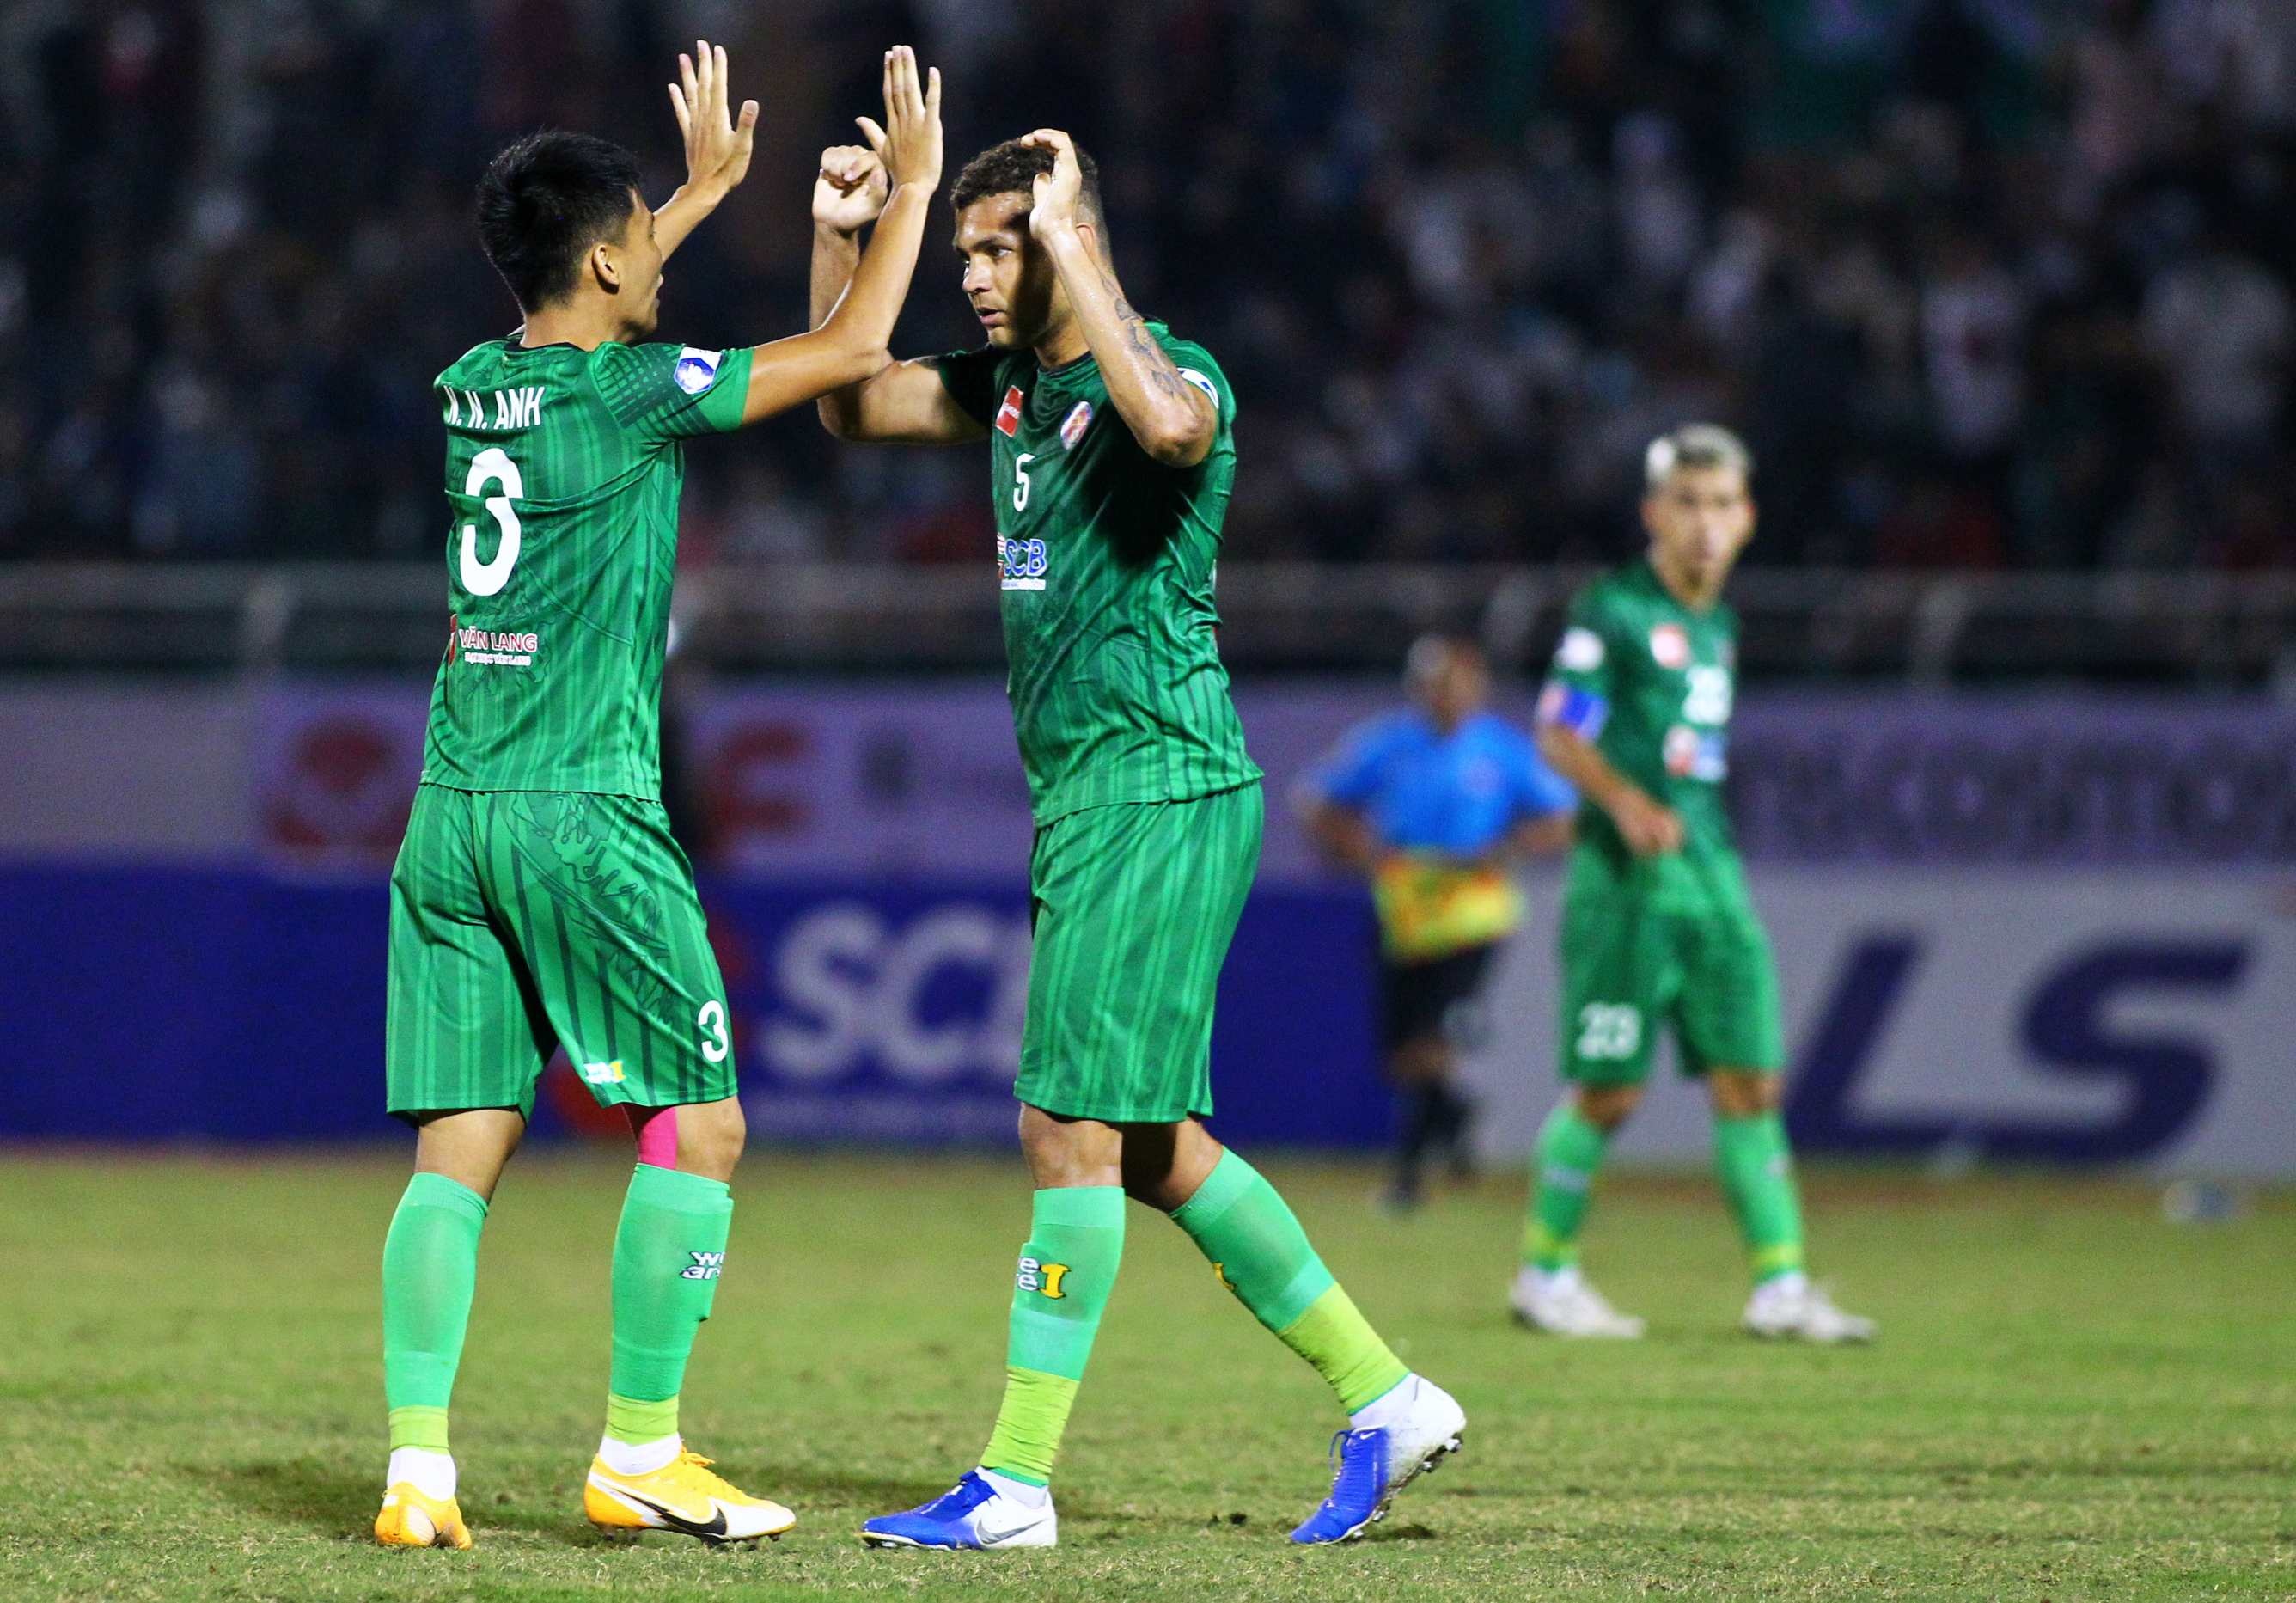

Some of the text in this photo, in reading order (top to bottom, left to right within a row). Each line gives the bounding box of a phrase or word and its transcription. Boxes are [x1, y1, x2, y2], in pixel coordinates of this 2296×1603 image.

[493, 386, 545, 429] ANH
[1013, 453, 1035, 511] 5
[459, 448, 523, 597] 3
[1004, 538, 1047, 577] SCB
[458, 626, 539, 652] VĂN LANG
[760, 900, 1031, 1080] SC
[697, 1000, 729, 1062] 3
[1787, 932, 2253, 1164] LS
